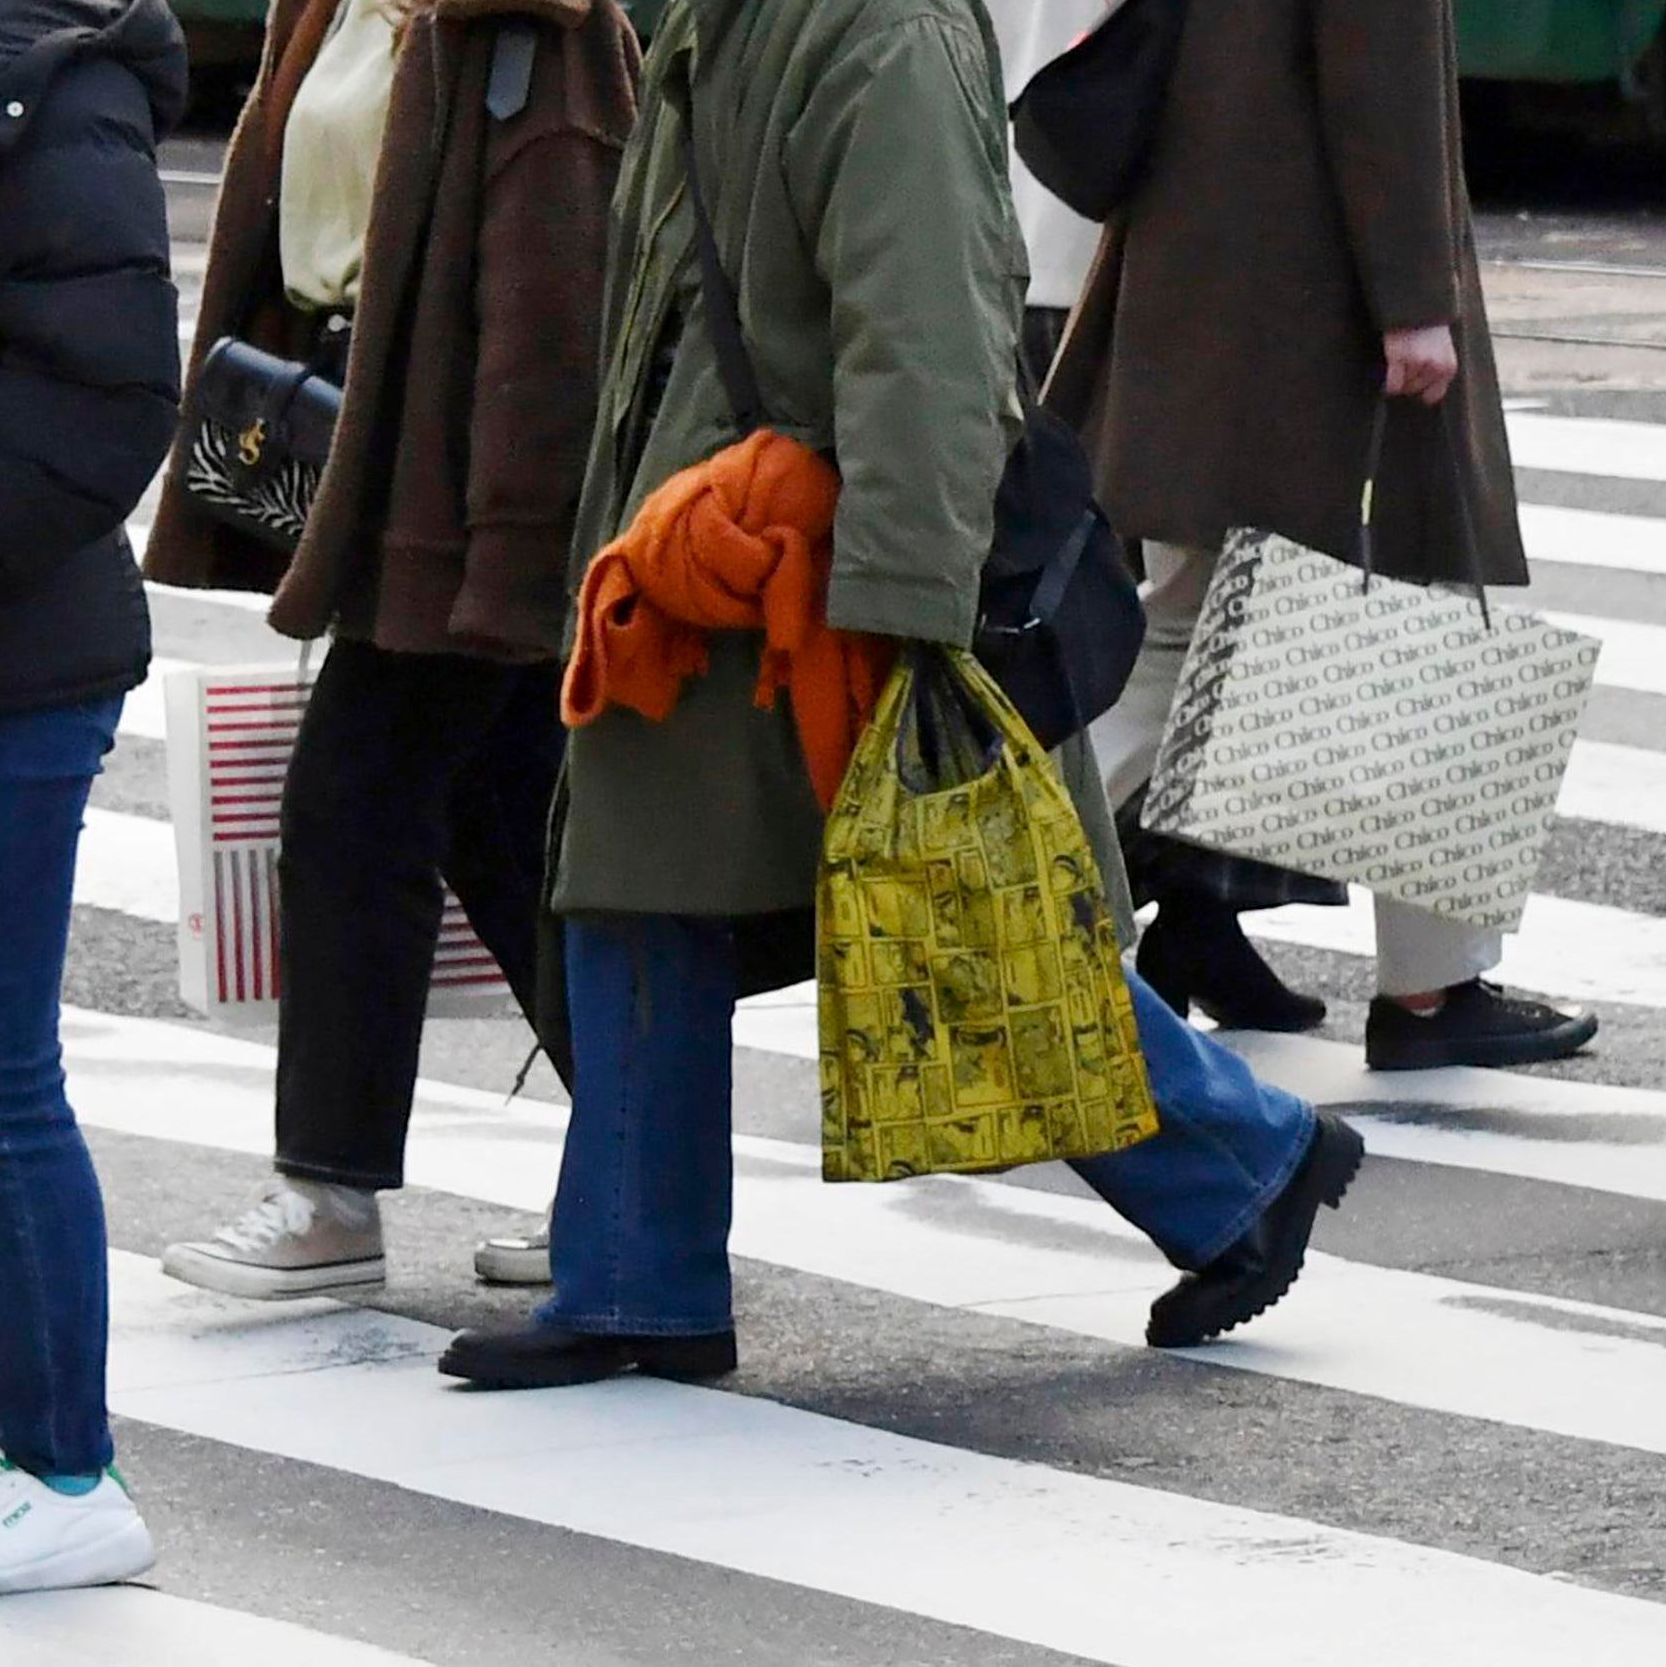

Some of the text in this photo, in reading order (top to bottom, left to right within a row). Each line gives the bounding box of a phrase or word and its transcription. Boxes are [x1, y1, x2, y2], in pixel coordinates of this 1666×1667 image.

[1252, 594, 1421, 648] Chico Chico Chico
[1275, 593, 1326, 615] Chico
[1230, 609, 1461, 681] Chico Chico Chico Chico
[1265, 676, 1317, 699] Chico
[1324, 661, 1374, 684] Chico
[1380, 643, 1437, 667] Chico
[1214, 658, 1572, 765] Chico Chico Chico Chico Chico Chico
[1240, 709, 1293, 732] Chico
[1299, 694, 1351, 716] Chico
[1357, 675, 1414, 701] Chico
[1420, 660, 1475, 685] Chico
[1481, 643, 1537, 666] Chico
[1252, 759, 1307, 783] Chico
[1313, 744, 1366, 767] Chico
[1371, 727, 1428, 751] Chico
[1433, 709, 1489, 734] Chico
[1494, 691, 1548, 717] Chico
[1225, 792, 1281, 815] Chico
[1288, 777, 1344, 801] Chico
[1350, 760, 1404, 784] Chico
[1410, 742, 1465, 767] Chico
[1471, 726, 1524, 751] Chico
[1261, 809, 1317, 834] Chico
[1324, 794, 1380, 818] Chico
[1386, 778, 1441, 801] Chico
[1446, 760, 1500, 784] Chico
[1505, 742, 1553, 767] Chico
[1296, 827, 1353, 850] Chico
[1360, 810, 1415, 834] Chico
[1421, 794, 1475, 818] Chico
[1481, 776, 1530, 800] Chico
[1332, 843, 1388, 867] Chico
[1395, 827, 1449, 851] Chico
[1455, 809, 1506, 833] Chico
[1366, 825, 1537, 883] Chico Chico Chico
[1401, 859, 1513, 897] Chico Chico
[1434, 893, 1491, 915] Chico
